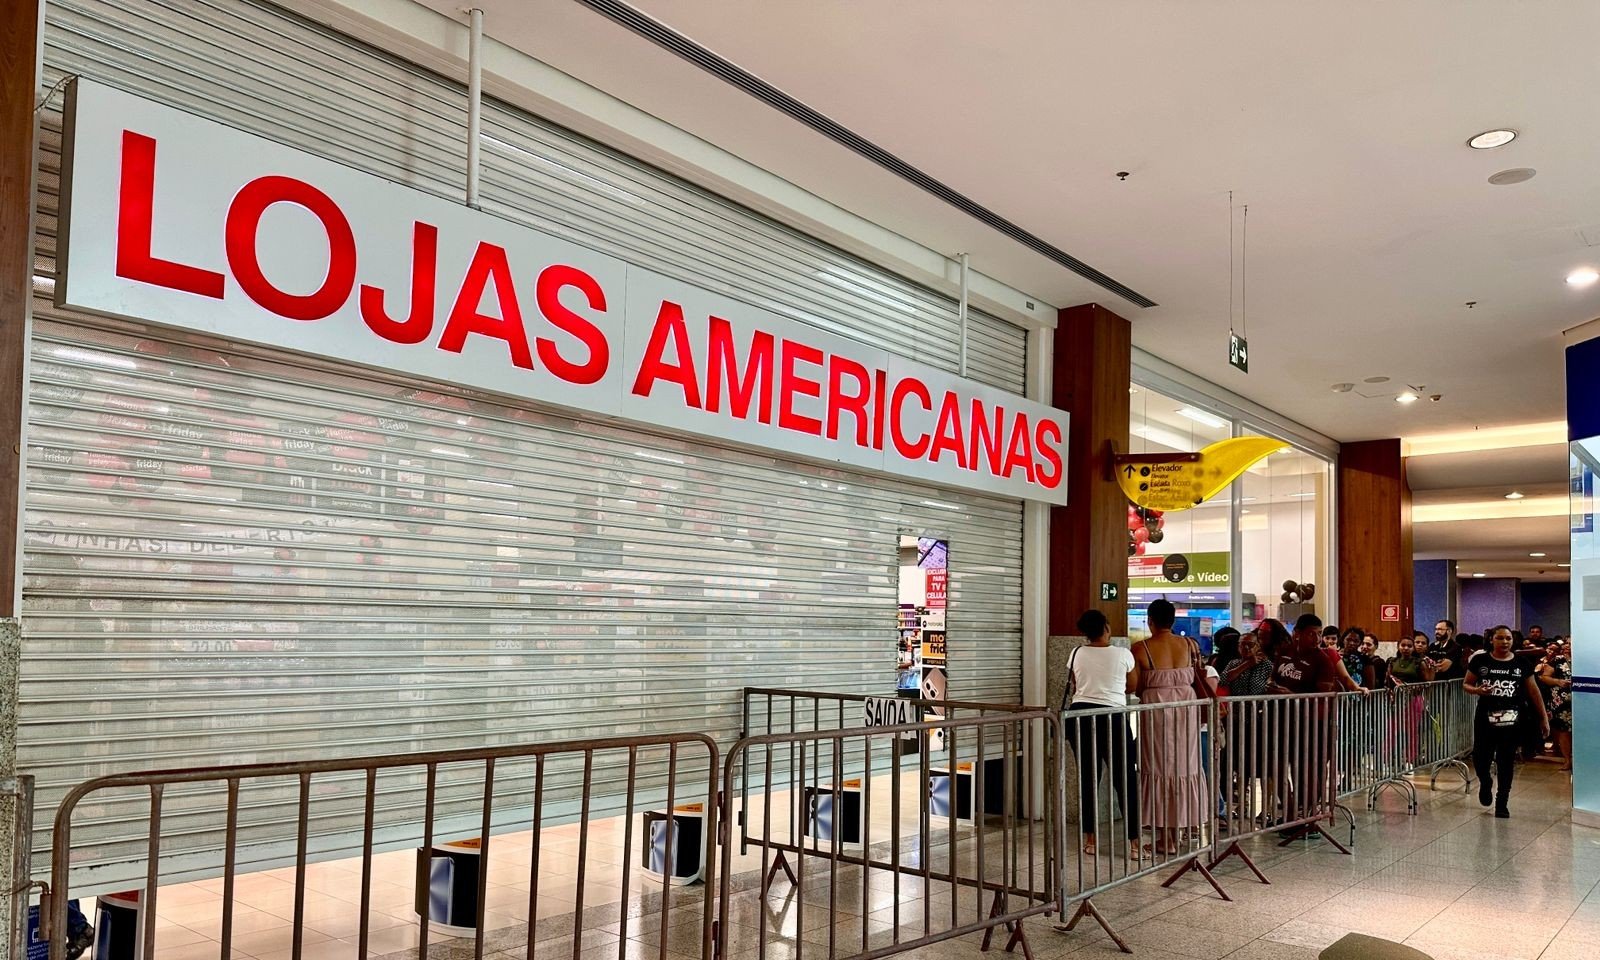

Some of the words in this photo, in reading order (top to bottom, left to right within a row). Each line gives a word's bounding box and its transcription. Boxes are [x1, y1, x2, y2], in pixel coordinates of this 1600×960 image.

[115, 129, 610, 385] LOJAS
[632, 300, 1064, 491] AMERICANAS
[1151, 464, 1183, 472] Elevador
[1197, 572, 1229, 583] Vídeo
[931, 582, 941, 591] TV
